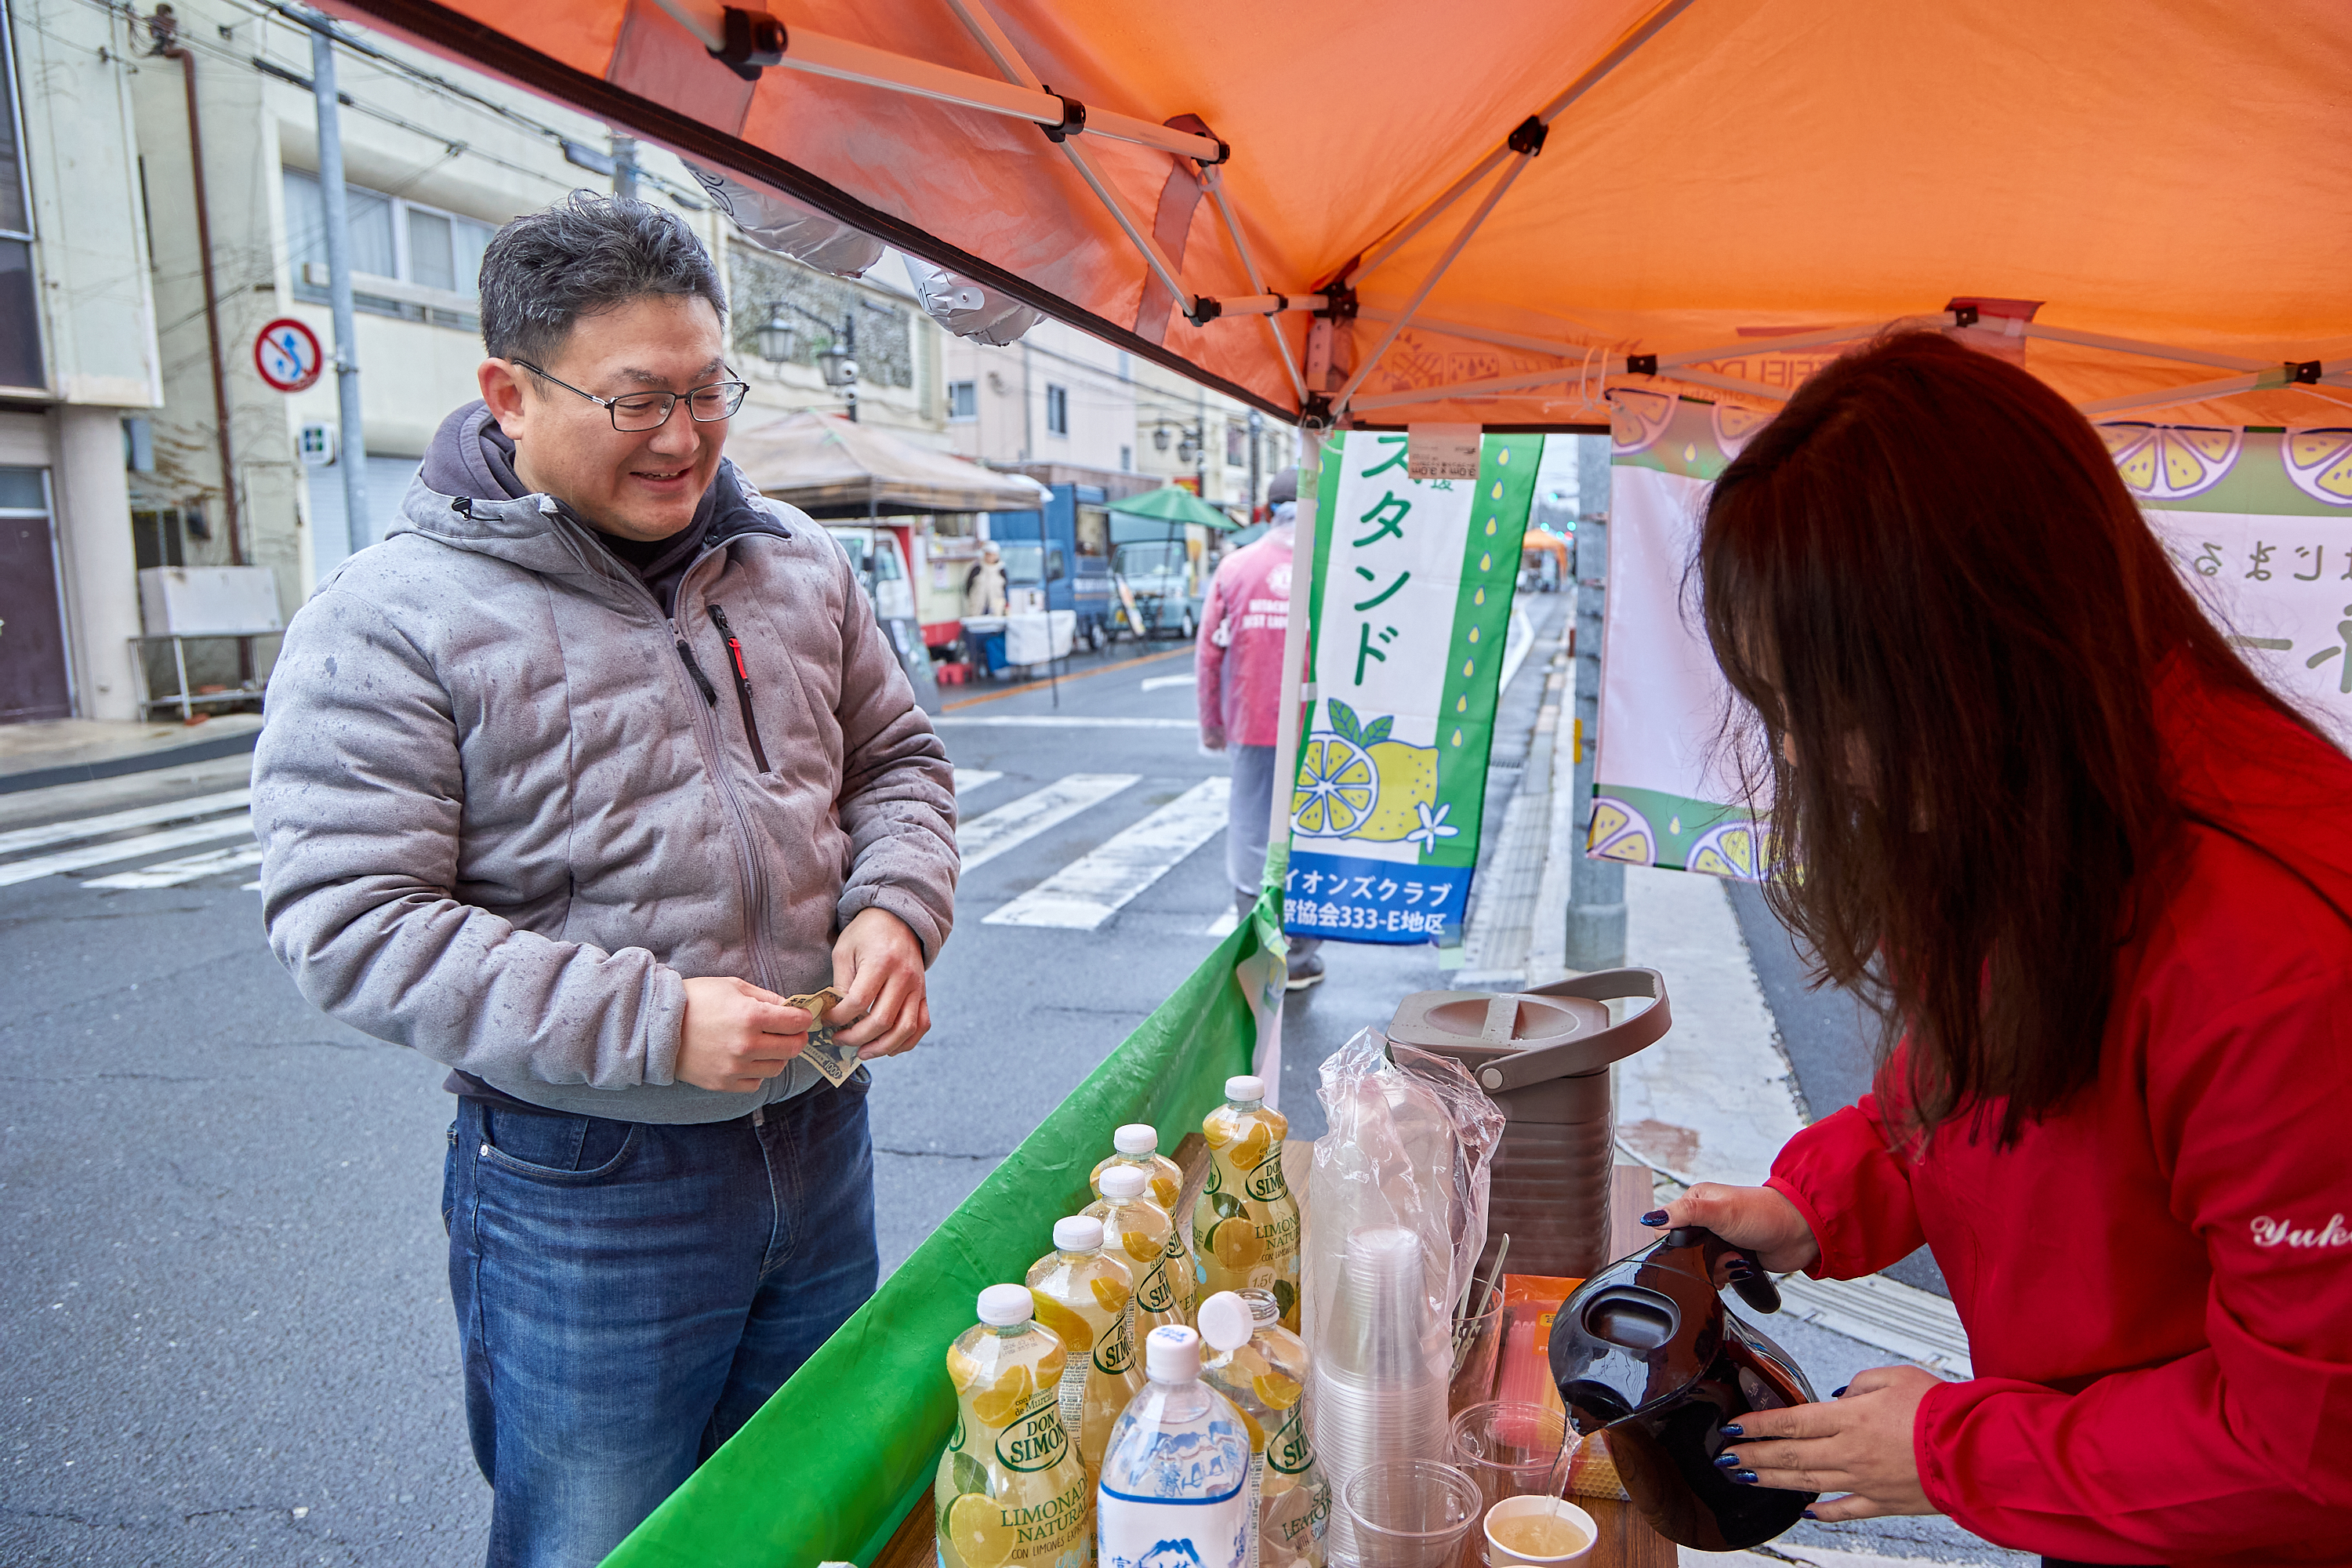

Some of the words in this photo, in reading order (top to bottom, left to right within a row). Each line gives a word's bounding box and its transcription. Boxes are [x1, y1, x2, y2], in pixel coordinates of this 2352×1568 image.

[824, 1062, 841, 1078] 1000
[1256, 1171, 1285, 1196] SIMO
[2250, 1213, 2352, 1248] Yuk
[1106, 1335, 1131, 1368] SIM
[1015, 1408, 1025, 1417] de
[1027, 1410, 1054, 1437] DON
[1011, 1418, 1065, 1464] SIMON
[1284, 1433, 1311, 1468] SIM
[1283, 1497, 1332, 1541] LEMON
[1012, 1548, 1029, 1559] CON
[1033, 1536, 1064, 1556] LIMONES
